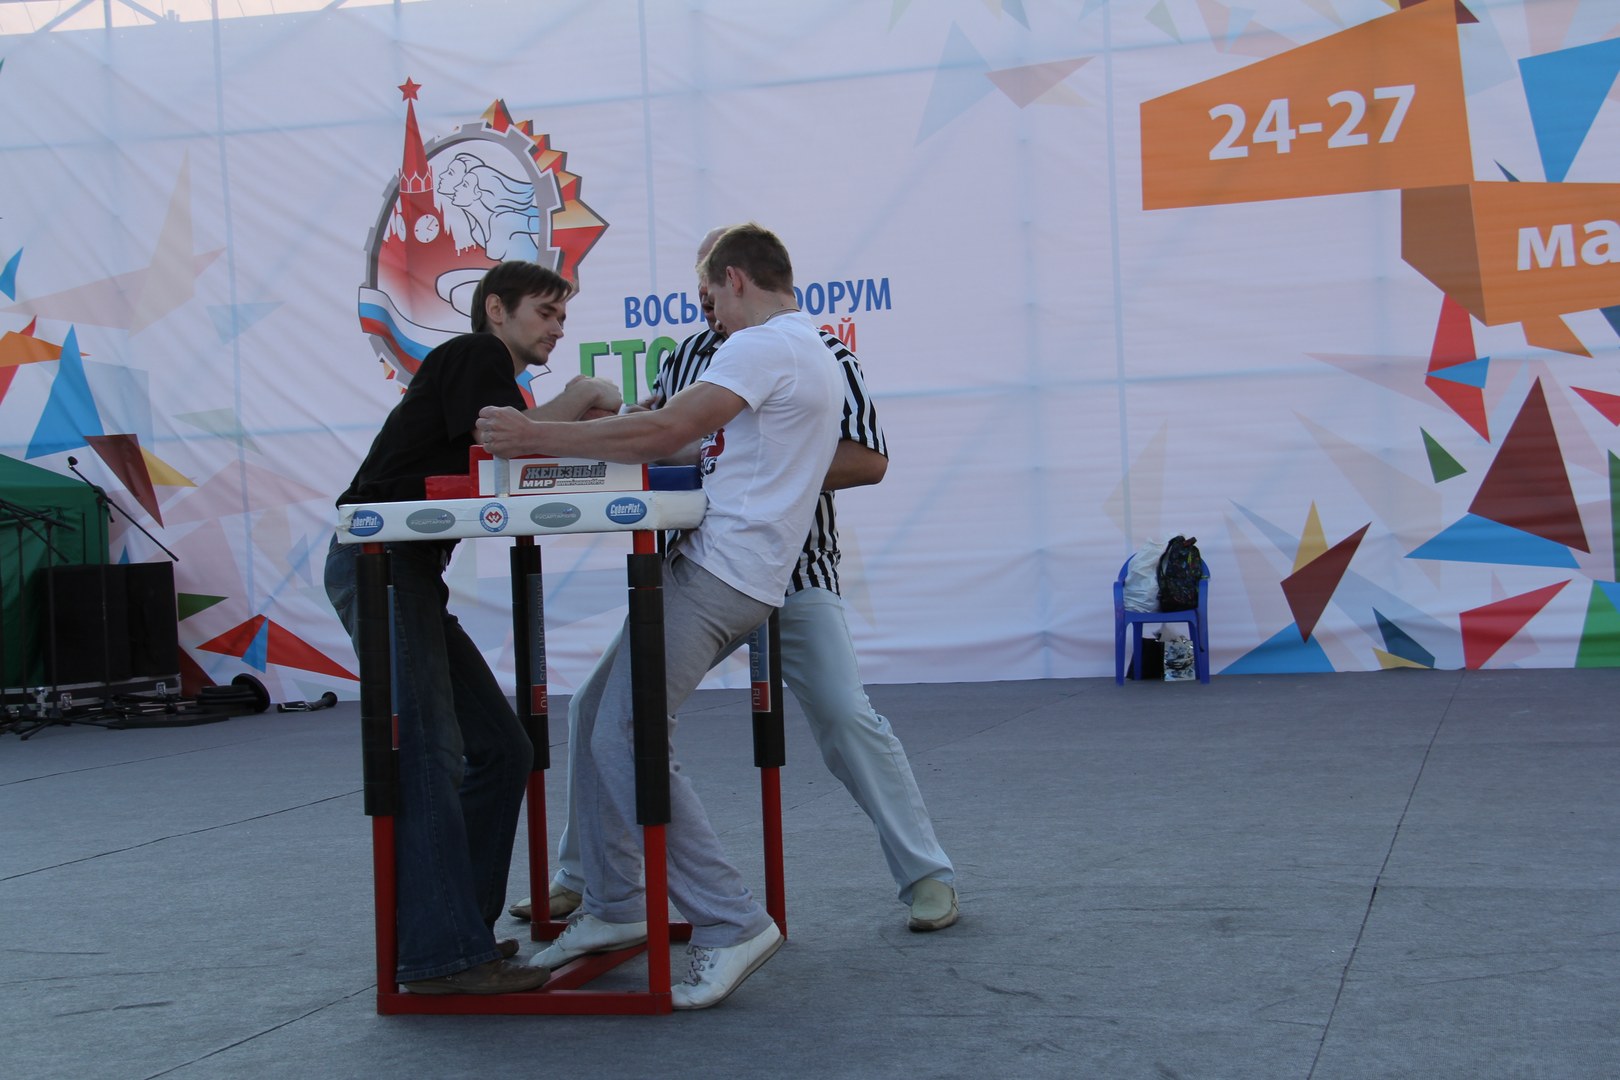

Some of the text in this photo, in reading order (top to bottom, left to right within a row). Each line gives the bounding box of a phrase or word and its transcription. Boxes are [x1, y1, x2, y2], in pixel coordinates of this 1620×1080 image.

[1208, 84, 1415, 161] 24-27
[624, 291, 706, 329] ВОСЬ
[525, 462, 607, 480] ЖЕЛЕЗНЫЙ
[522, 479, 553, 488] МИР
[610, 503, 640, 516] CyberPlat
[351, 516, 377, 529] yberPlat
